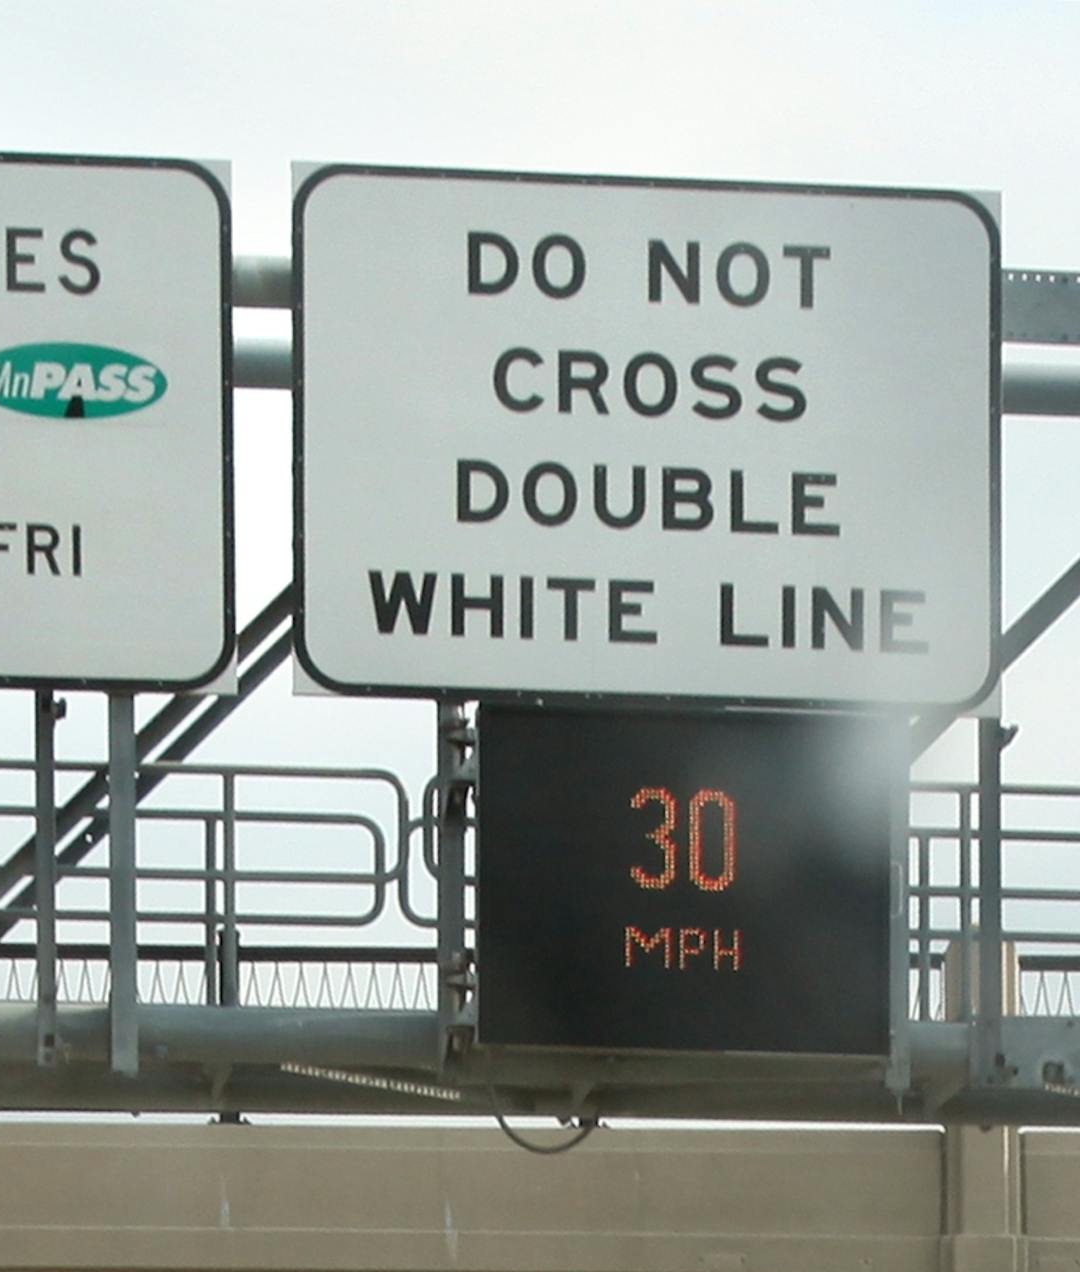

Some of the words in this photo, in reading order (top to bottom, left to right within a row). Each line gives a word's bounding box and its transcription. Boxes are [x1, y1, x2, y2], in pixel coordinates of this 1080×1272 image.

[466, 229, 587, 301] DO
[647, 237, 832, 311] NOT
[492, 346, 808, 424] CROSS
[455, 457, 841, 538] DOUBLE
[367, 568, 659, 646] WHITE
[718, 582, 930, 655] LINE
[630, 787, 738, 892] 30
[623, 925, 743, 971] MPH
